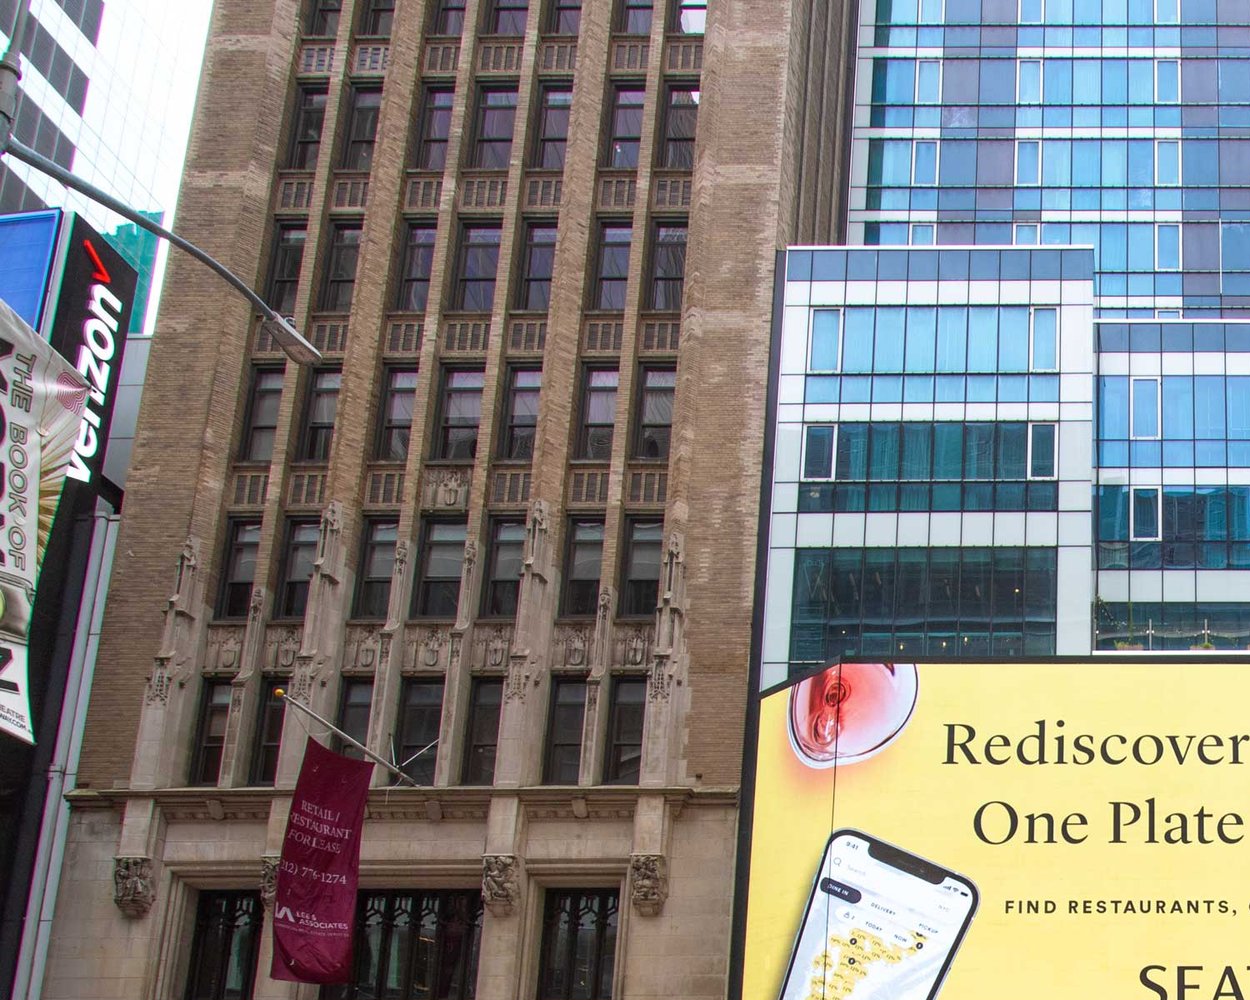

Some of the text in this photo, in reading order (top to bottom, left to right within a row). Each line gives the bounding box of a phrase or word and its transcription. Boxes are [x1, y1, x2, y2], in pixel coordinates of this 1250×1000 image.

[10, 353, 37, 413] THE
[66, 283, 123, 484] verizon
[9, 421, 29, 518] BOOK
[8, 525, 27, 572] OF
[942, 720, 1250, 766] Rediscover
[301, 800, 334, 821] RETAIL
[974, 801, 1088, 845] One
[1109, 798, 1243, 845] Plate
[288, 829, 341, 854] FOR LEASE
[302, 866, 346, 885] 776-1274
[827, 883, 849, 896] DINE IN
[870, 902, 896, 916] DELIVERY
[1005, 901, 1056, 914] FIND
[1069, 900, 1237, 917] RESTAURANTS,
[299, 918, 349, 930] ASSOCIATES
[865, 921, 883, 932] TODAY
[918, 922, 939, 934] PICKUP
[894, 934, 908, 943] NOW
